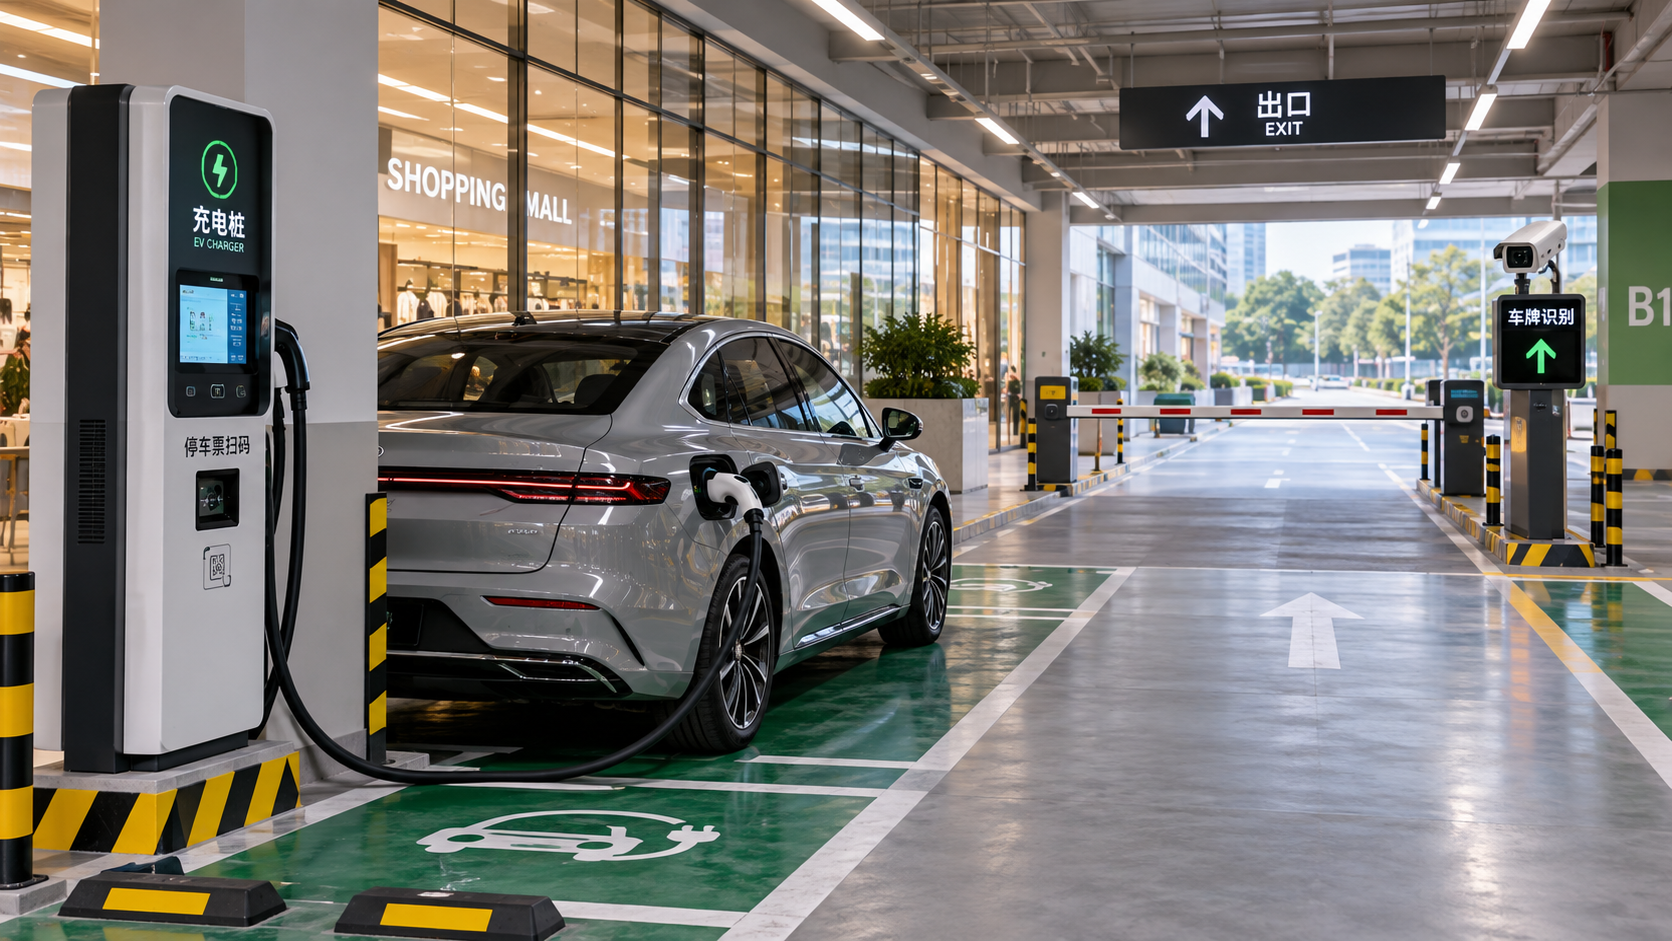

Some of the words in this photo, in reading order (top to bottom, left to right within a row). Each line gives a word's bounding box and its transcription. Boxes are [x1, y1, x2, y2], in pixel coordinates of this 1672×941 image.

[1257, 90, 1311, 119] 出口
[1265, 121, 1303, 136] EXIT
[387, 157, 506, 211] SHOPPING
[527, 190, 572, 225] MALL
[193, 205, 245, 238] 充电桩
[194, 237, 205, 248] EV
[206, 238, 245, 253] CHARGER
[1508, 307, 1574, 326] 车牌识别
[1628, 285, 1671, 327] B1
[184, 435, 250, 458] 停车票扫码
